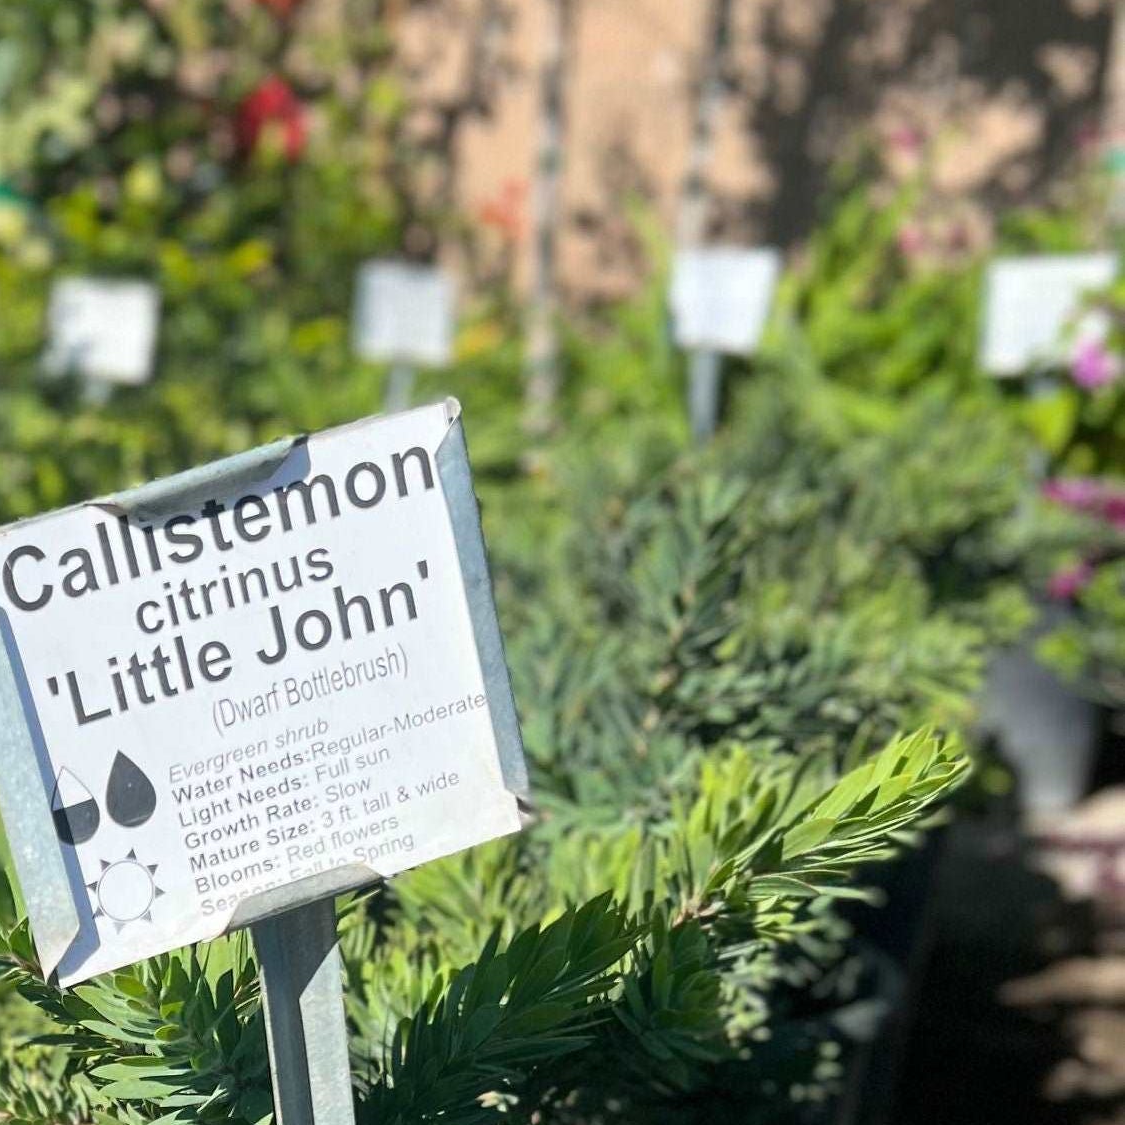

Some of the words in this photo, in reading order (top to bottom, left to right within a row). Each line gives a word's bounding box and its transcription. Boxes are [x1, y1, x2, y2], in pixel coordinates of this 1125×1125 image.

[2, 446, 435, 612] Callistemon
[136, 546, 334, 634] citrinus
[46, 636, 233, 726] 'Little
[256, 560, 429, 666] John'
[212, 680, 281, 739] (Dwarf
[284, 643, 409, 709] Bottlebrush)
[169, 739, 268, 784] Evergreen
[275, 717, 329, 749] shrub
[172, 775, 233, 804] Water
[178, 799, 232, 828] Light
[237, 774, 310, 810] Needs:
[315, 757, 350, 783] Full
[355, 748, 391, 770] sun
[184, 812, 260, 850] Growth
[266, 795, 319, 823] Rate:
[325, 777, 371, 804] Slow
[189, 839, 261, 873] Mature
[266, 819, 316, 846] Size:
[321, 811, 334, 829] 3
[362, 791, 391, 816] tall
[397, 785, 411, 803] &
[415, 771, 460, 798] wide
[353, 833, 415, 863] Spring
[195, 856, 281, 895] Blooms:
[286, 837, 325, 864] Red
[330, 815, 400, 850] flowers
